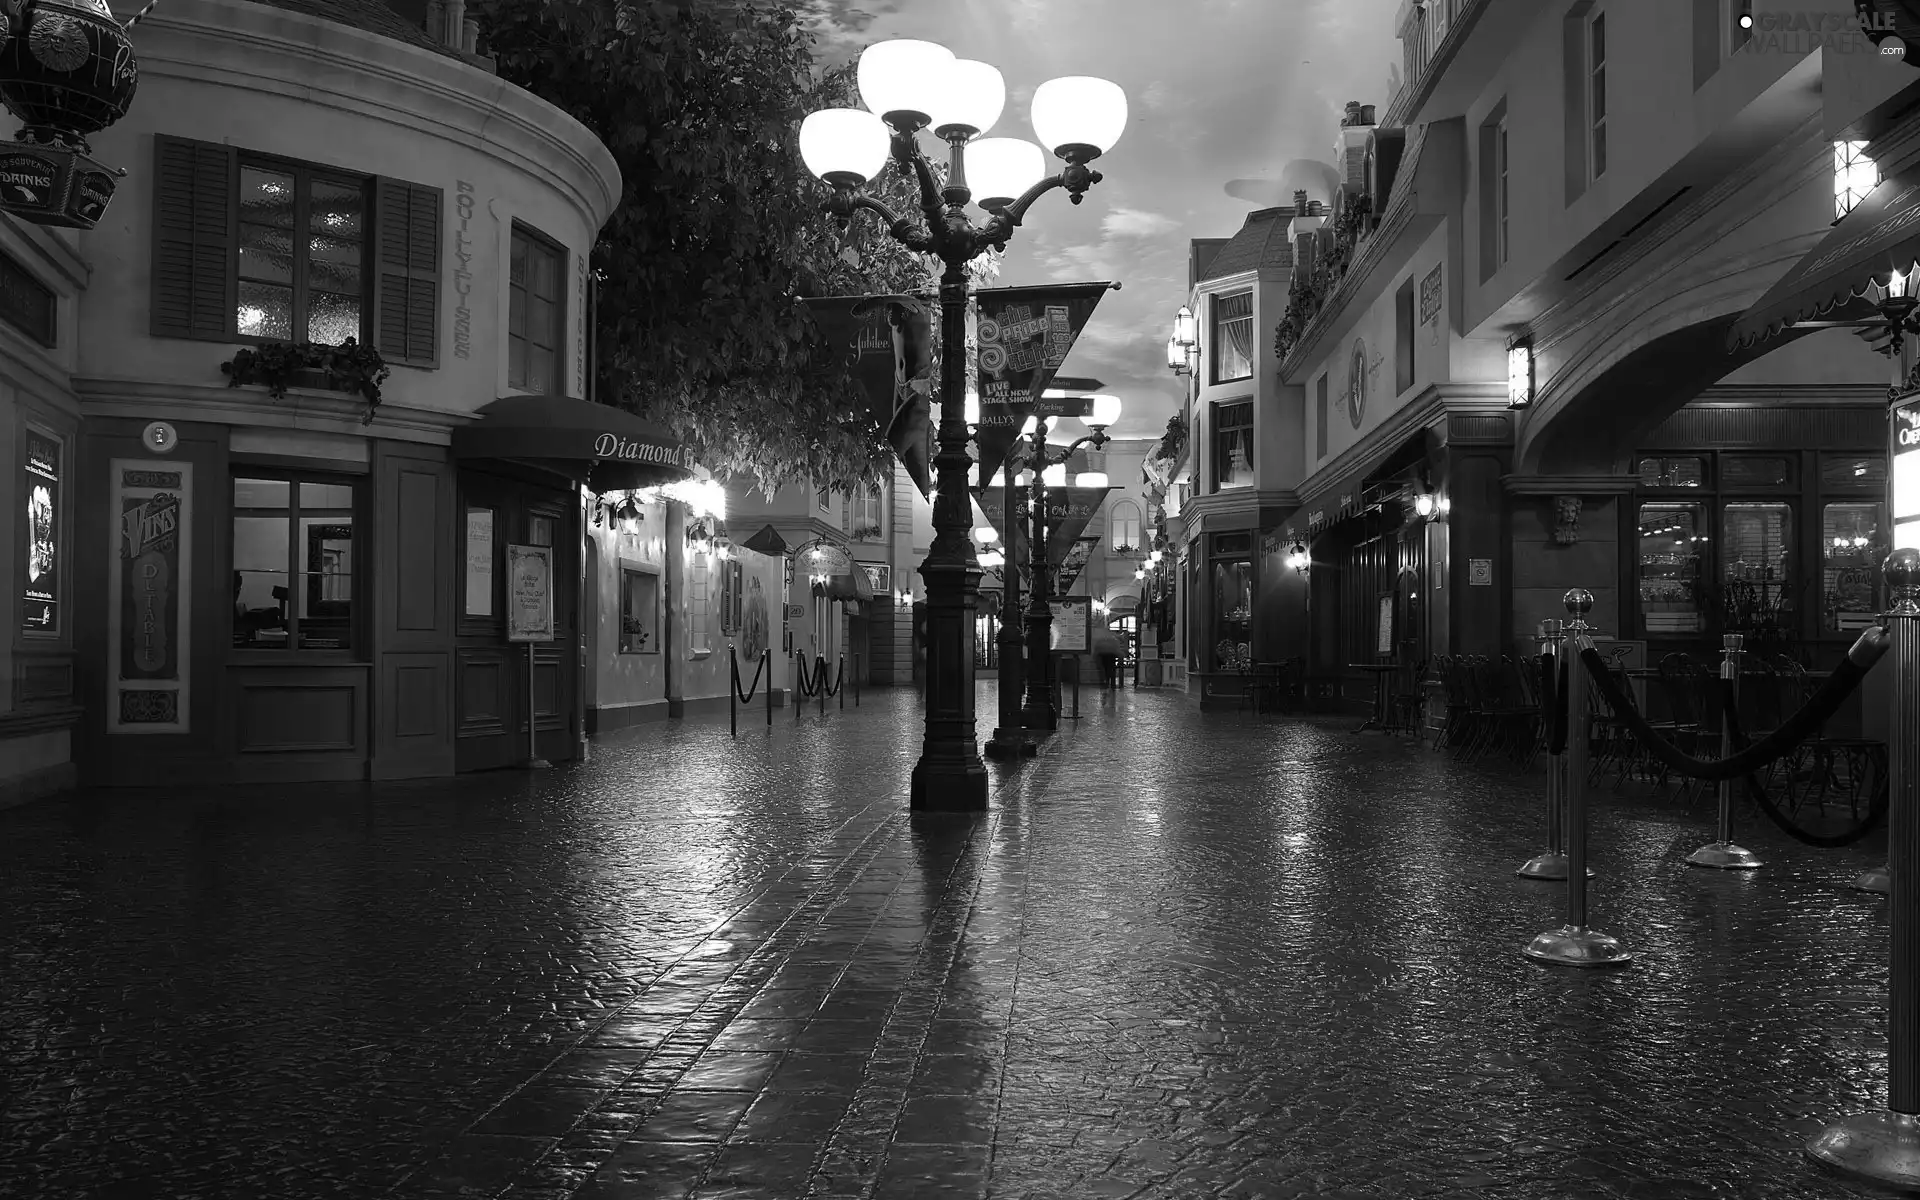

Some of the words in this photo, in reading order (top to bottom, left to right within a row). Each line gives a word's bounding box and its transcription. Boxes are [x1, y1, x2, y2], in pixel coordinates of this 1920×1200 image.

[0, 171, 51, 188] DRINKS
[985, 381, 1010, 396] LIVE
[1010, 389, 1031, 397] NEW
[1008, 395, 1034, 404] SHOW
[1039, 402, 1065, 412] Parking
[982, 415, 1015, 425] BALLY'S
[594, 432, 683, 466] Diamond
[122, 502, 177, 559] VINS
